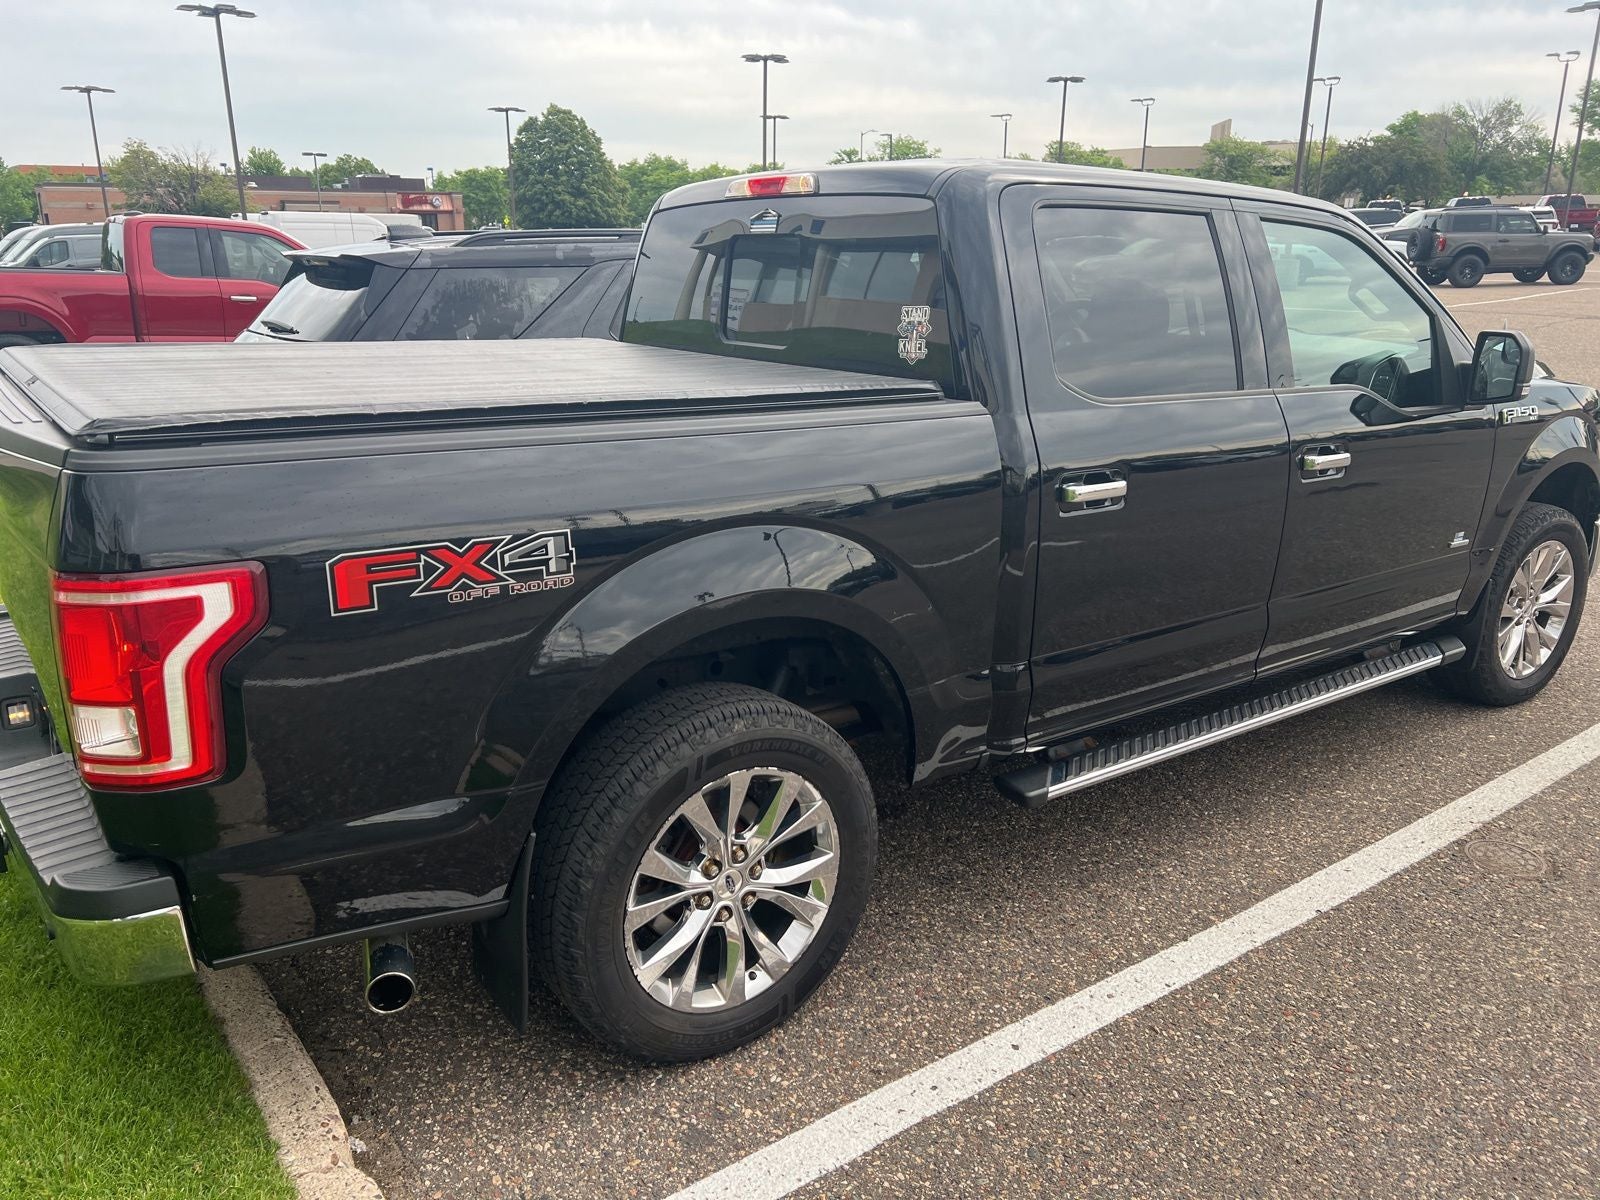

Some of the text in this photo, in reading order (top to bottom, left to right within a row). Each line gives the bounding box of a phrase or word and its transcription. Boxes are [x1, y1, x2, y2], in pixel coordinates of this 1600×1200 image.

[901, 307, 930, 321] STAND
[899, 340, 926, 353] KNEEL
[326, 529, 576, 617] FX4
[448, 576, 575, 603] OFF ROAD
